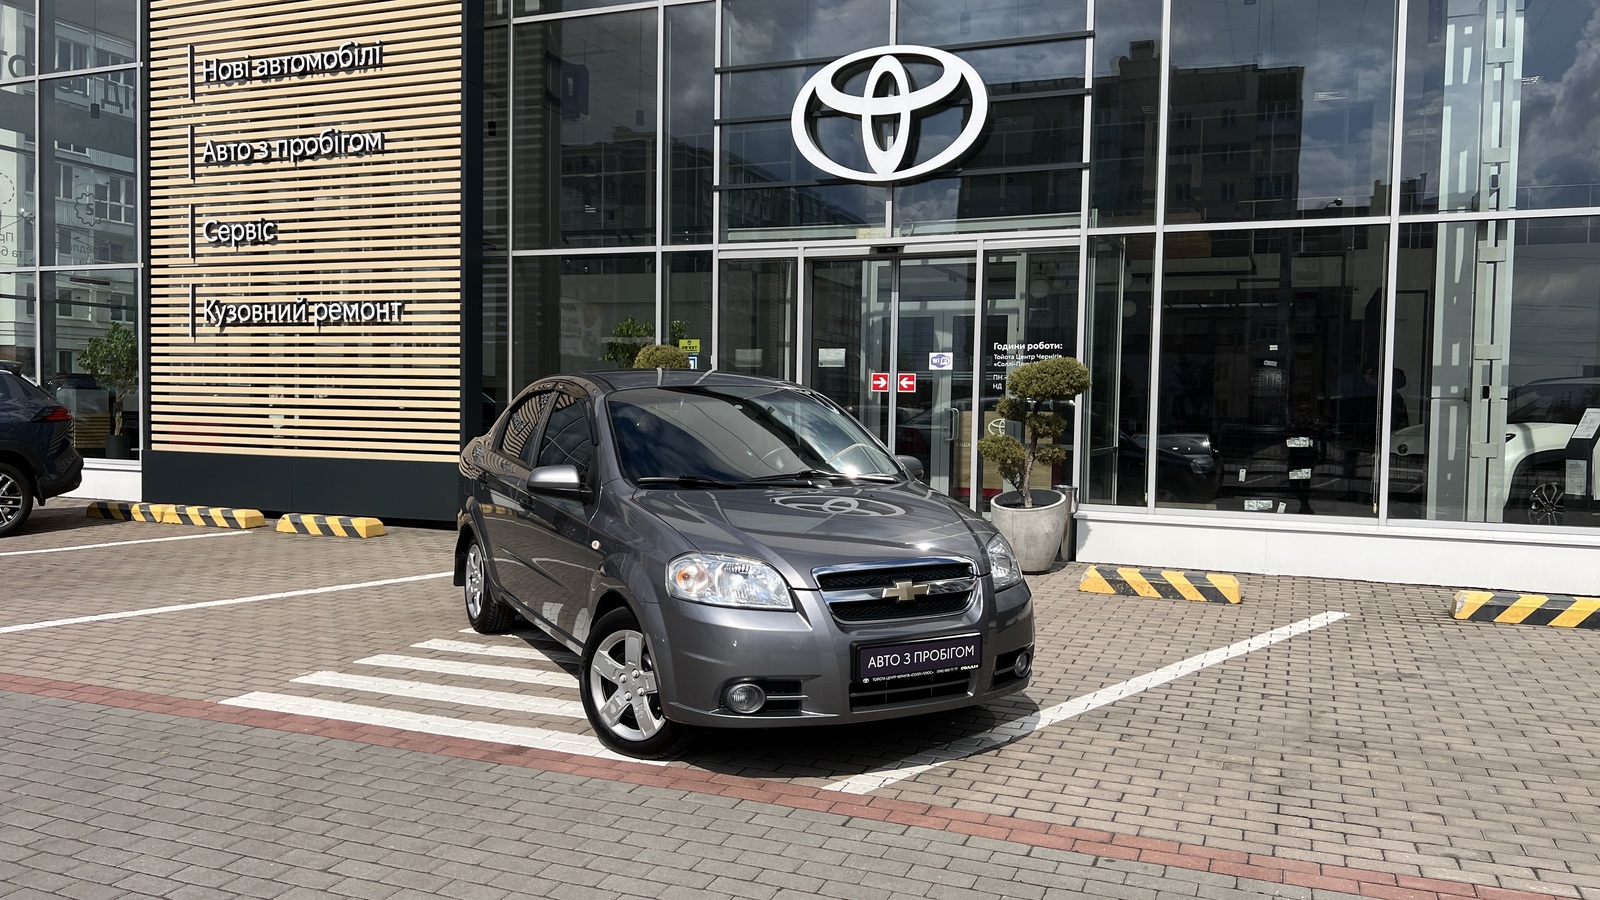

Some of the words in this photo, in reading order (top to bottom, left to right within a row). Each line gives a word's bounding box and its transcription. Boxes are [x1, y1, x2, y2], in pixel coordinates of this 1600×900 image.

[202, 54, 250, 82] Нові
[256, 40, 382, 77] автомобілі
[202, 139, 252, 163] Авто
[258, 141, 269, 159] з
[276, 128, 383, 163] пробігом
[202, 217, 276, 247] Сервіс
[203, 297, 308, 327] Кузовний
[313, 302, 403, 326] ремонт
[993, 342, 1026, 351] Години
[1026, 341, 1063, 351] роботи:
[867, 653, 901, 669] АВТО
[914, 645, 975, 664] ПРОБІГОМ
